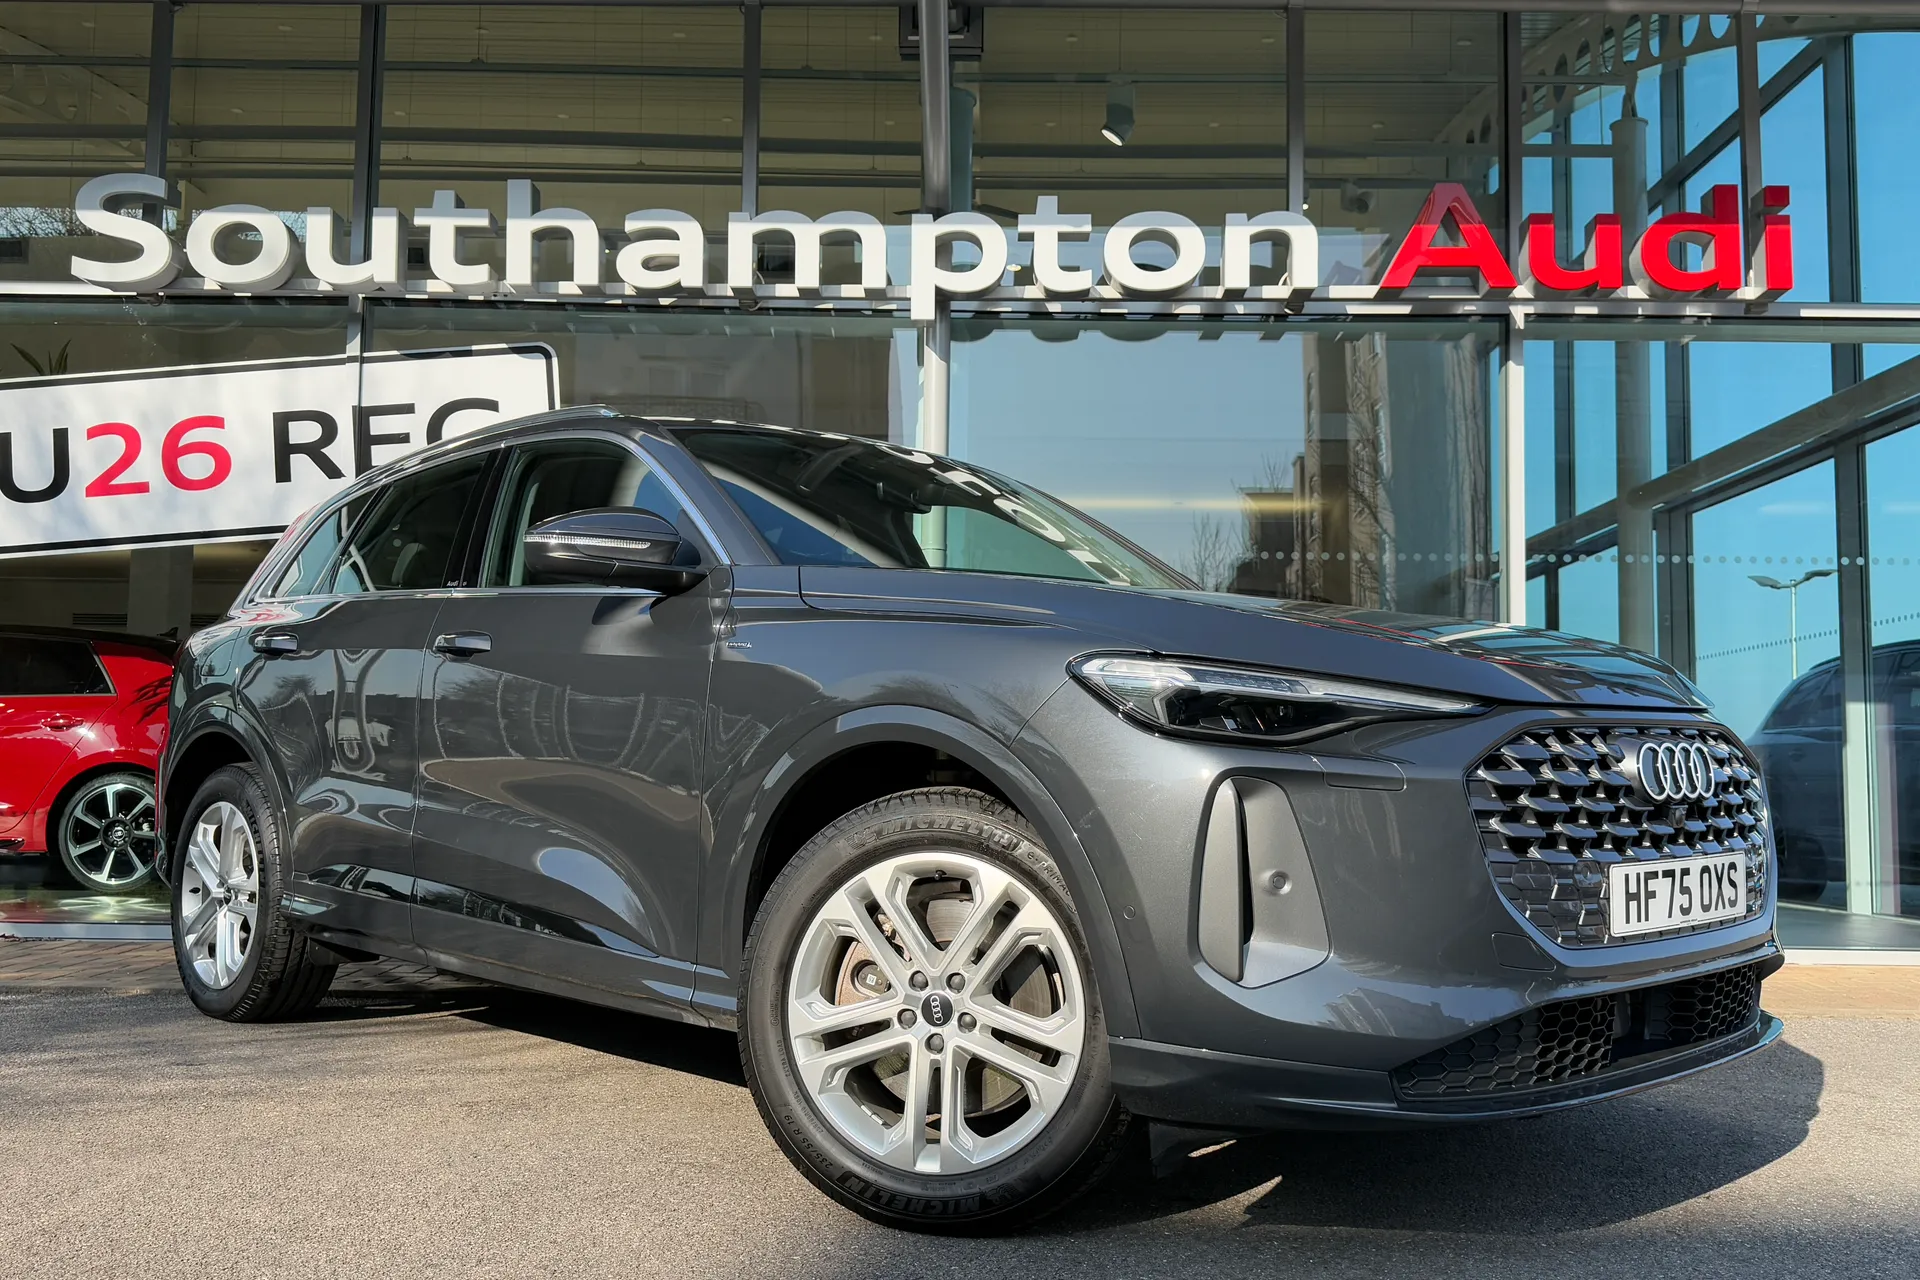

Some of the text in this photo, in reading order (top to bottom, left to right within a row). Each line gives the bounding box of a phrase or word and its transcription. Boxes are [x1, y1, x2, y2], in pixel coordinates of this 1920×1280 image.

[71, 173, 1794, 321] Southampton Audi
[882, 814, 1019, 850] MICHELIN
[1624, 861, 1738, 925] HF75 OXS
[784, 1114, 834, 1169] 235/55 R 19
[844, 1174, 981, 1215] MICHELIN
